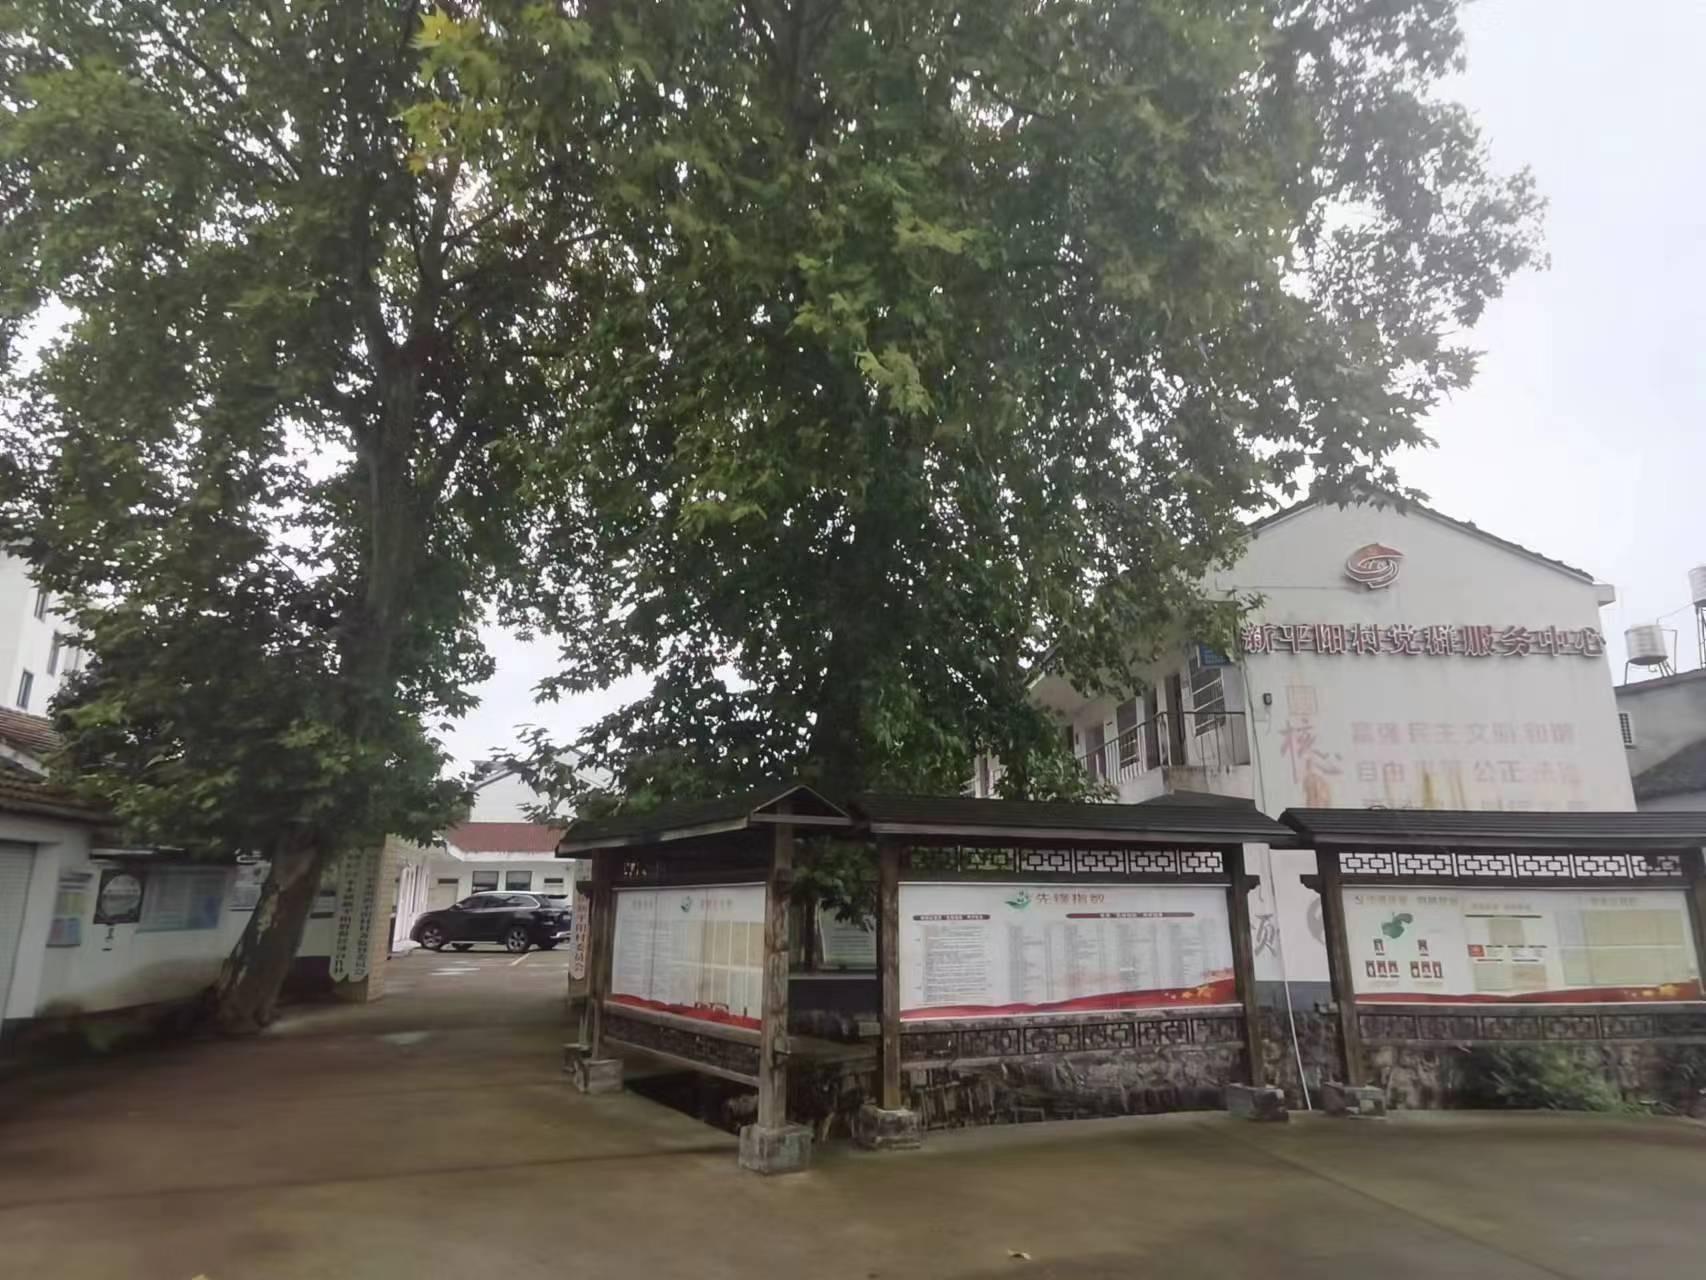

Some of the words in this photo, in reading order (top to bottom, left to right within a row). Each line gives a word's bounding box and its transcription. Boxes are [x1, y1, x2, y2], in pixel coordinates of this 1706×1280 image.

[1241, 623, 1606, 657] 新平阳村党群服务中心
